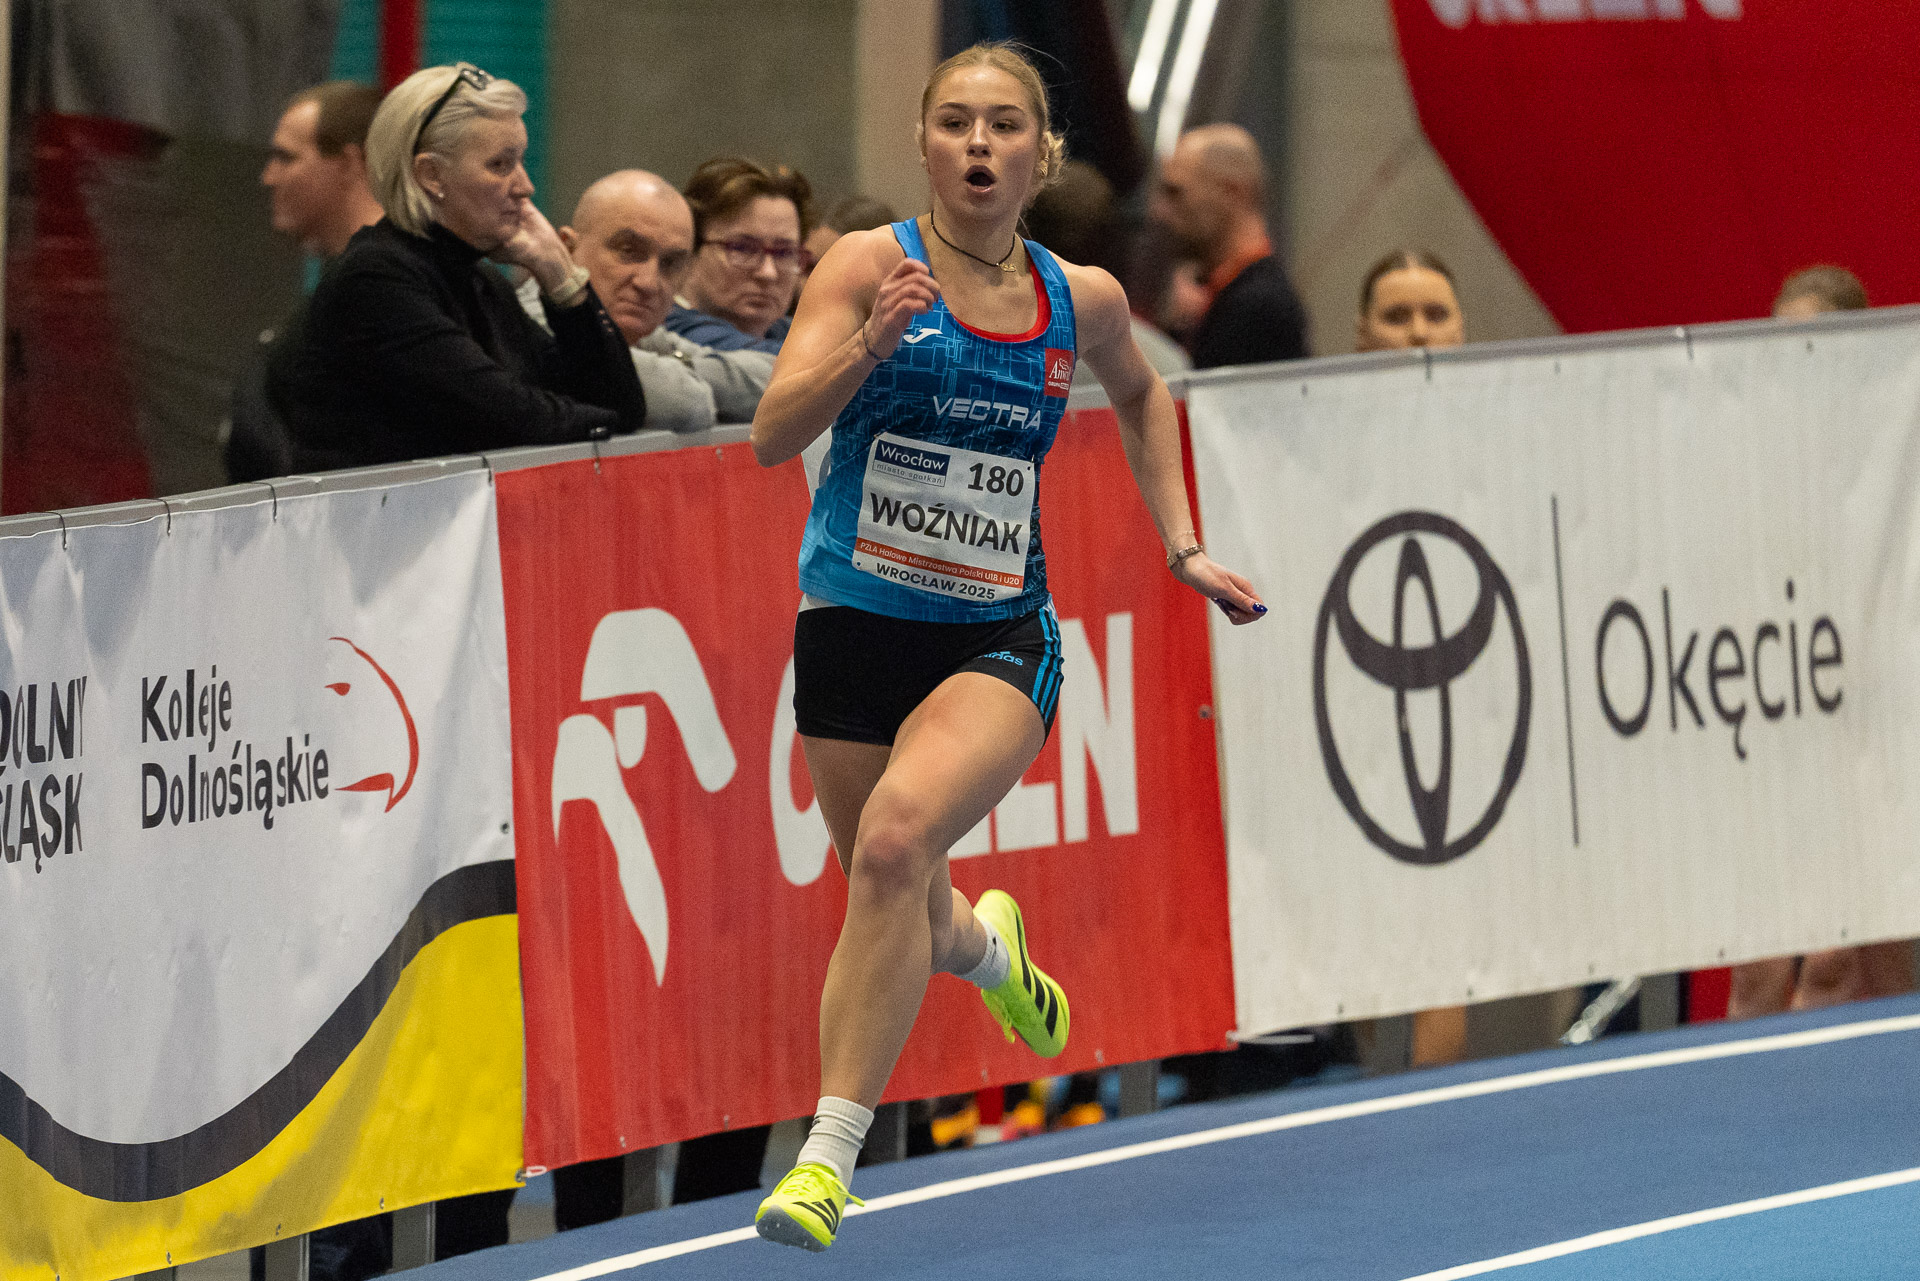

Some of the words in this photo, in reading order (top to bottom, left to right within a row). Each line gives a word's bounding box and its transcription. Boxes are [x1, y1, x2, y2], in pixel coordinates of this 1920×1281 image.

[933, 396, 1041, 430] VECTRA
[876, 464, 906, 476] miasto
[881, 444, 946, 471] Wrocław
[968, 462, 1024, 497] 180
[870, 492, 1023, 555] WOŹNIAK
[876, 562, 957, 592] WROCŁAW
[958, 583, 996, 600] 2025
[879, 547, 907, 561] Halowe
[908, 556, 958, 574] Mistrzostwa
[959, 567, 983, 579] Polski
[984, 573, 998, 581] U18
[1003, 575, 1020, 585] U20
[1594, 576, 1844, 761] Okęcie
[141, 664, 232, 753] Koleje
[141, 733, 329, 831] Dolnośląskie
[0, 765, 83, 874] LĄSK
